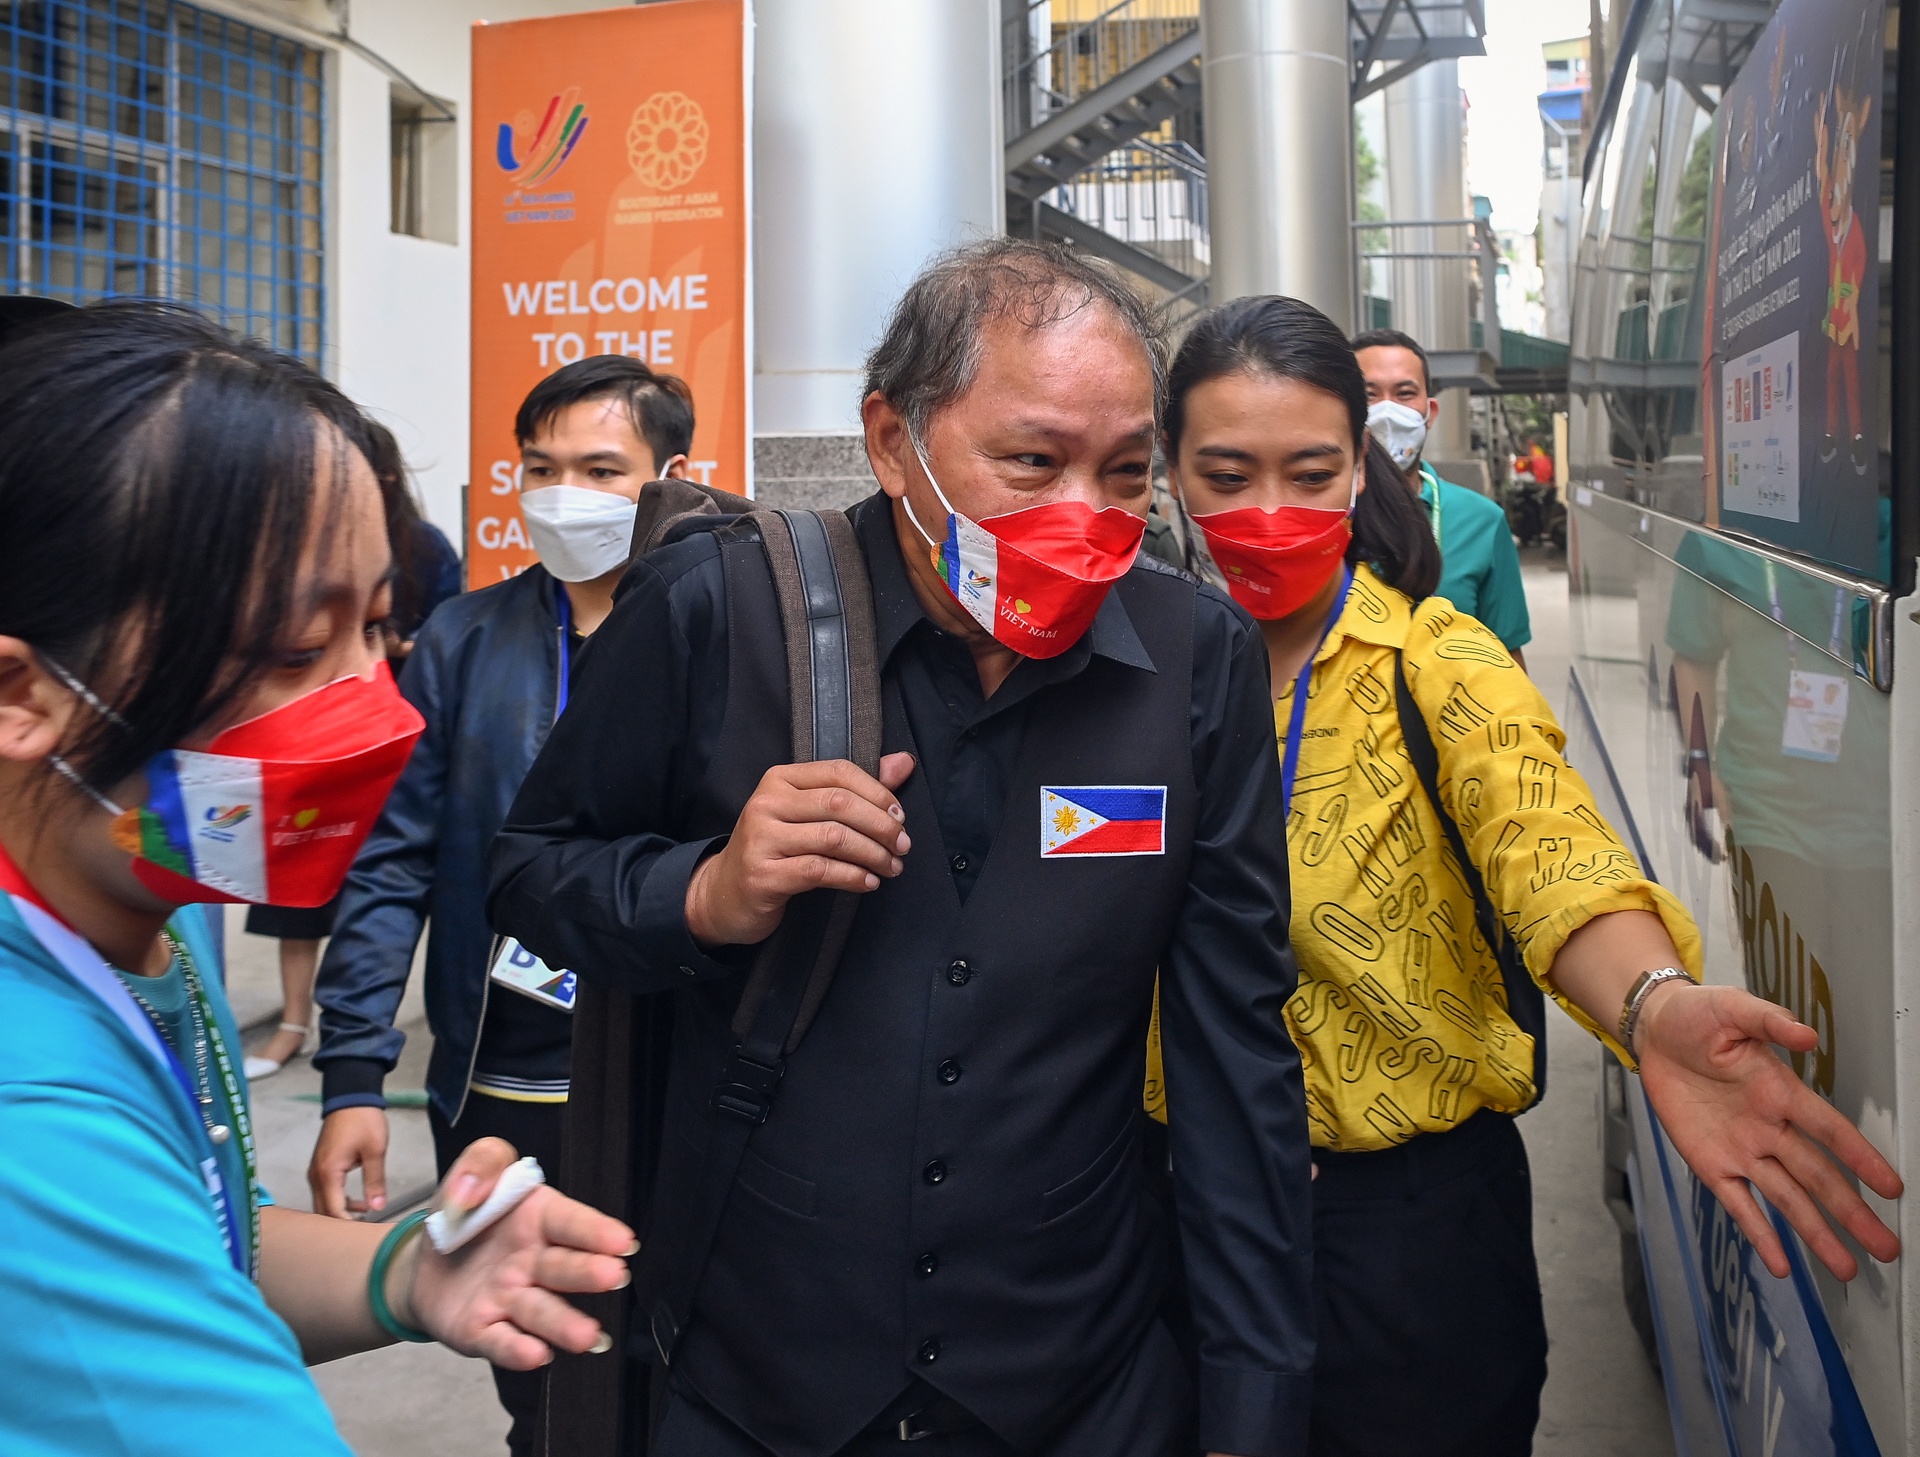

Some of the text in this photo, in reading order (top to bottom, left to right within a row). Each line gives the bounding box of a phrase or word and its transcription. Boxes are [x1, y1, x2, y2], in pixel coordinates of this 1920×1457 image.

[502, 275, 708, 316] WELCOME
[532, 330, 673, 367] TO THE
[1005, 595, 1013, 604] I
[1000, 605, 1058, 639] VIET NAM
[210, 1026, 257, 1167] STRONGER
